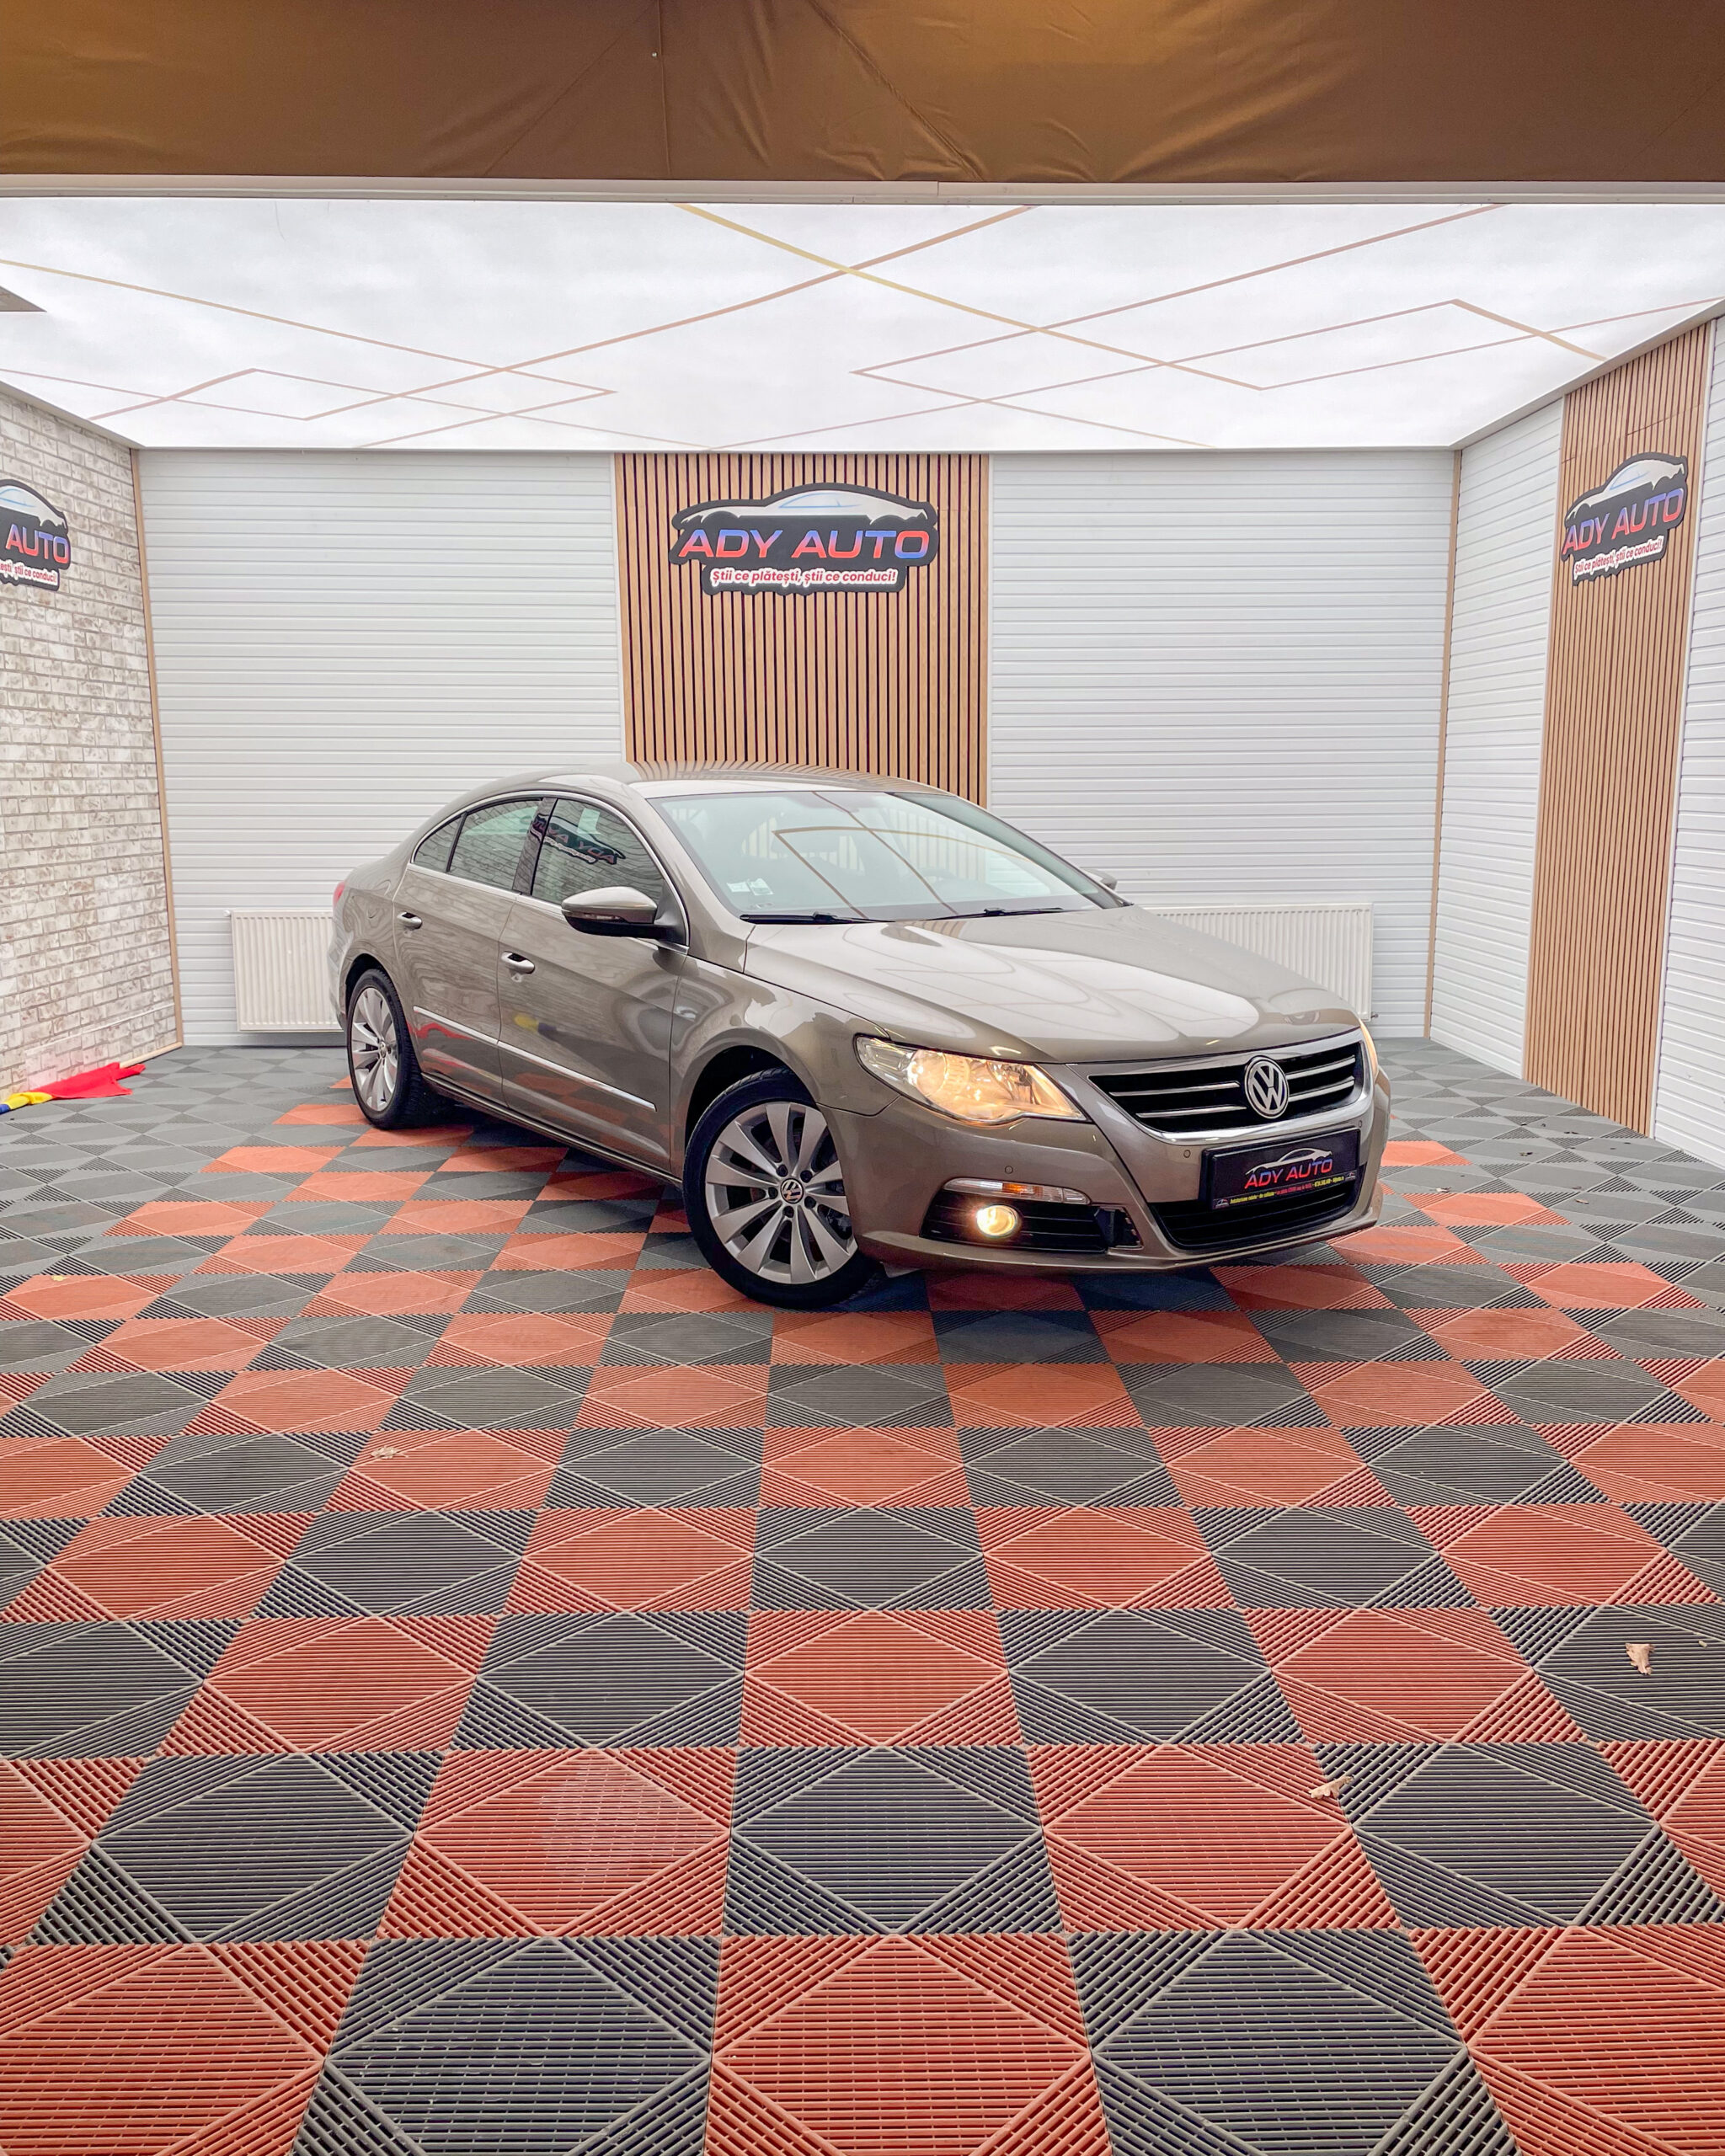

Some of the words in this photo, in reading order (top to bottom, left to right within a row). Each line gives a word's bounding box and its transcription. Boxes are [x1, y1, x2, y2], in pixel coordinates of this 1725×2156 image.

[1562, 512, 1610, 555] ADY
[1611, 488, 1684, 540] AUTO
[5, 524, 69, 564] AUTO
[678, 529, 783, 558] ADY
[791, 530, 931, 559] AUTO
[1634, 538, 1663, 555] conduci!
[713, 570, 733, 583] Știi
[734, 573, 749, 582] ce
[751, 570, 802, 584] plătești,
[804, 571, 823, 584] știi
[825, 574, 841, 582] ce
[842, 571, 897, 583] conduci!
[1247, 1058, 1288, 1117] VW
[1244, 1168, 1284, 1189] ADY
[1285, 1159, 1333, 1181] AUTO
